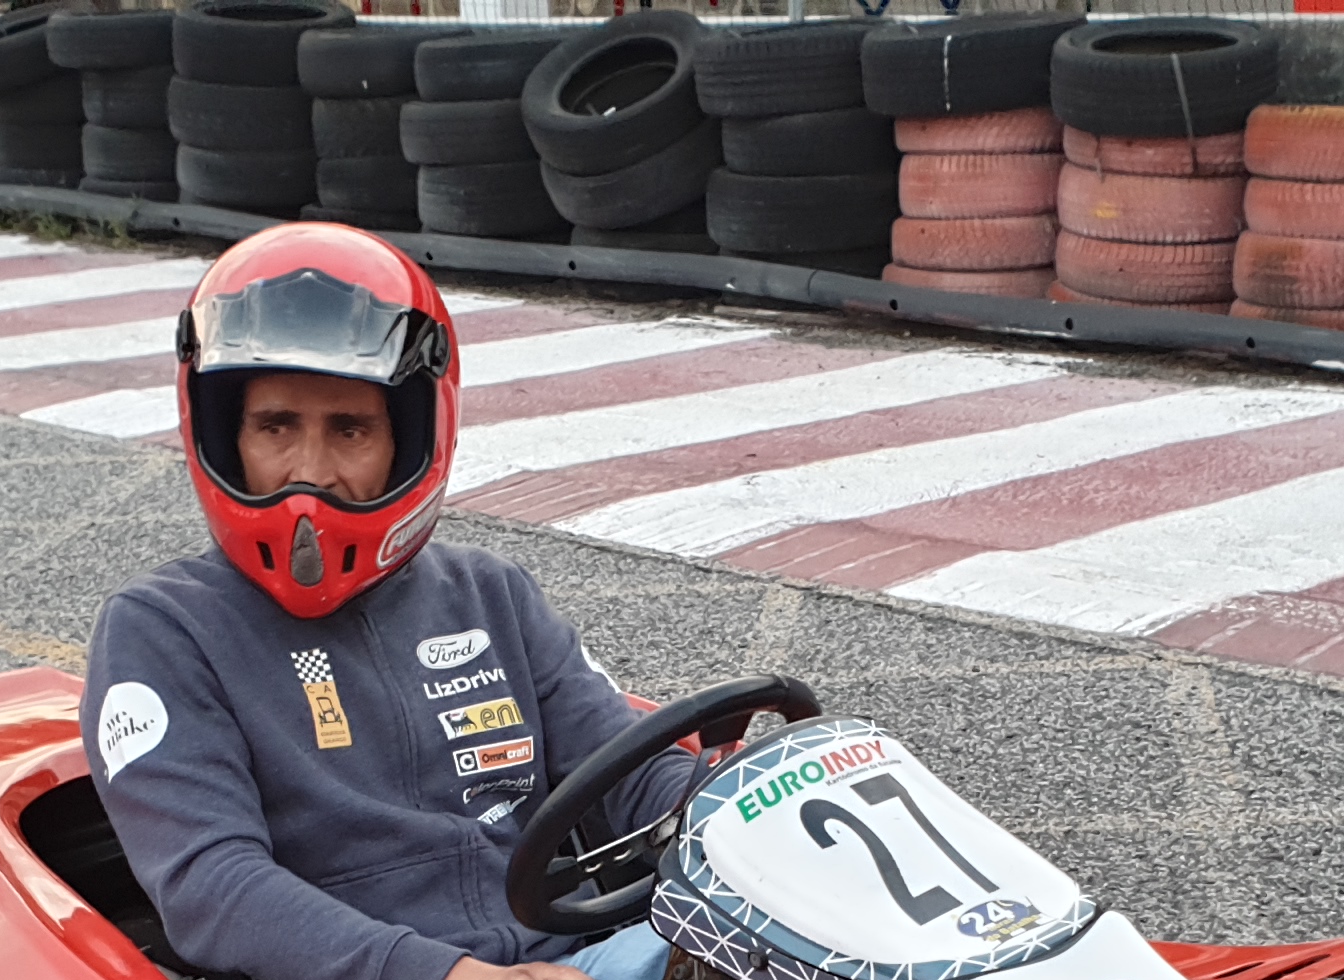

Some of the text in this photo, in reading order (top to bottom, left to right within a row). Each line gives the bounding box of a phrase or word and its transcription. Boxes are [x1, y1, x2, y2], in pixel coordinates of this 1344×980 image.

[427, 638, 476, 665] Ford
[735, 740, 887, 824] EUROINDY
[799, 773, 1001, 927] 27
[960, 901, 1016, 935] 24
